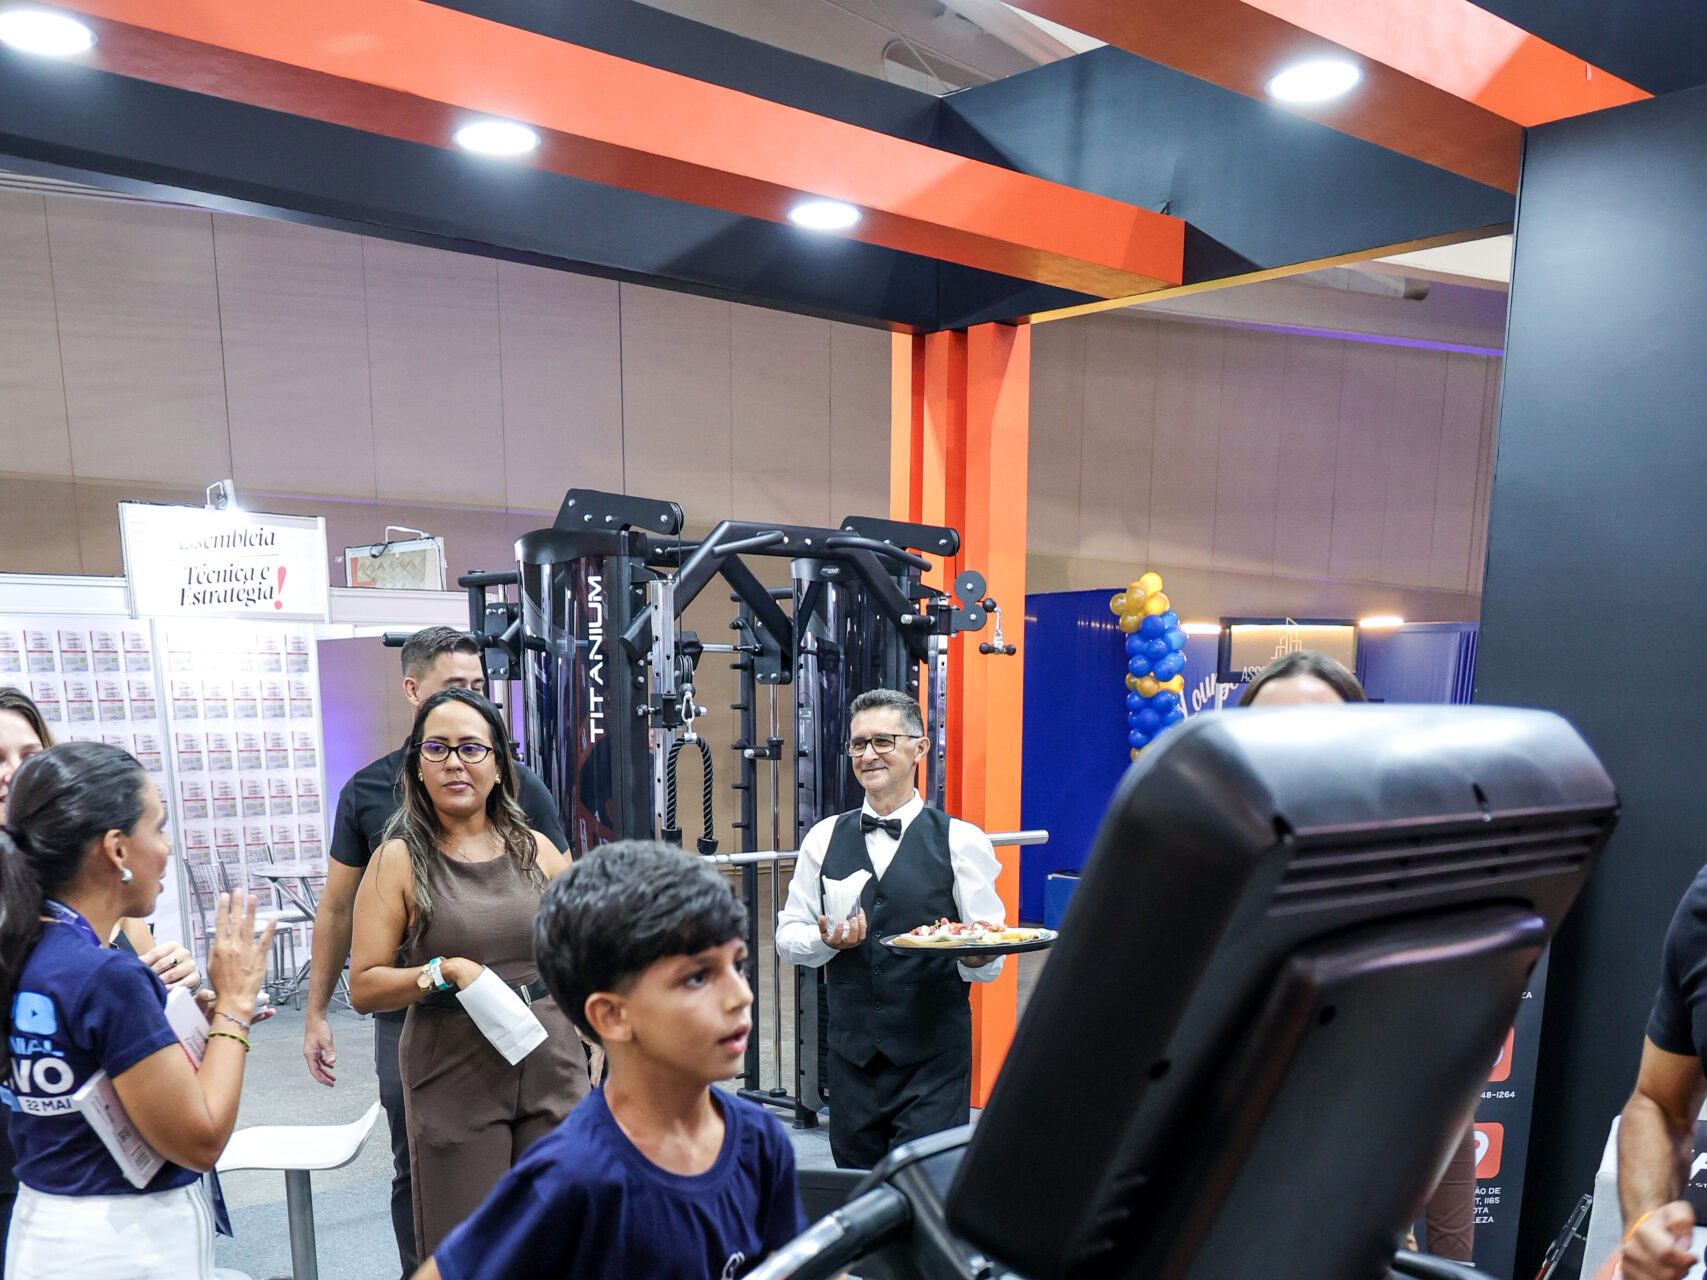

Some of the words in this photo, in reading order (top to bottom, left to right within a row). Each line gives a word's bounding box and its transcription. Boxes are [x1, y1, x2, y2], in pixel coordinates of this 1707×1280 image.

[179, 526, 275, 552] ssembleia
[184, 562, 255, 586] Técnica
[588, 575, 604, 743] TITANIUM
[1488, 1187, 1501, 1195] DE
